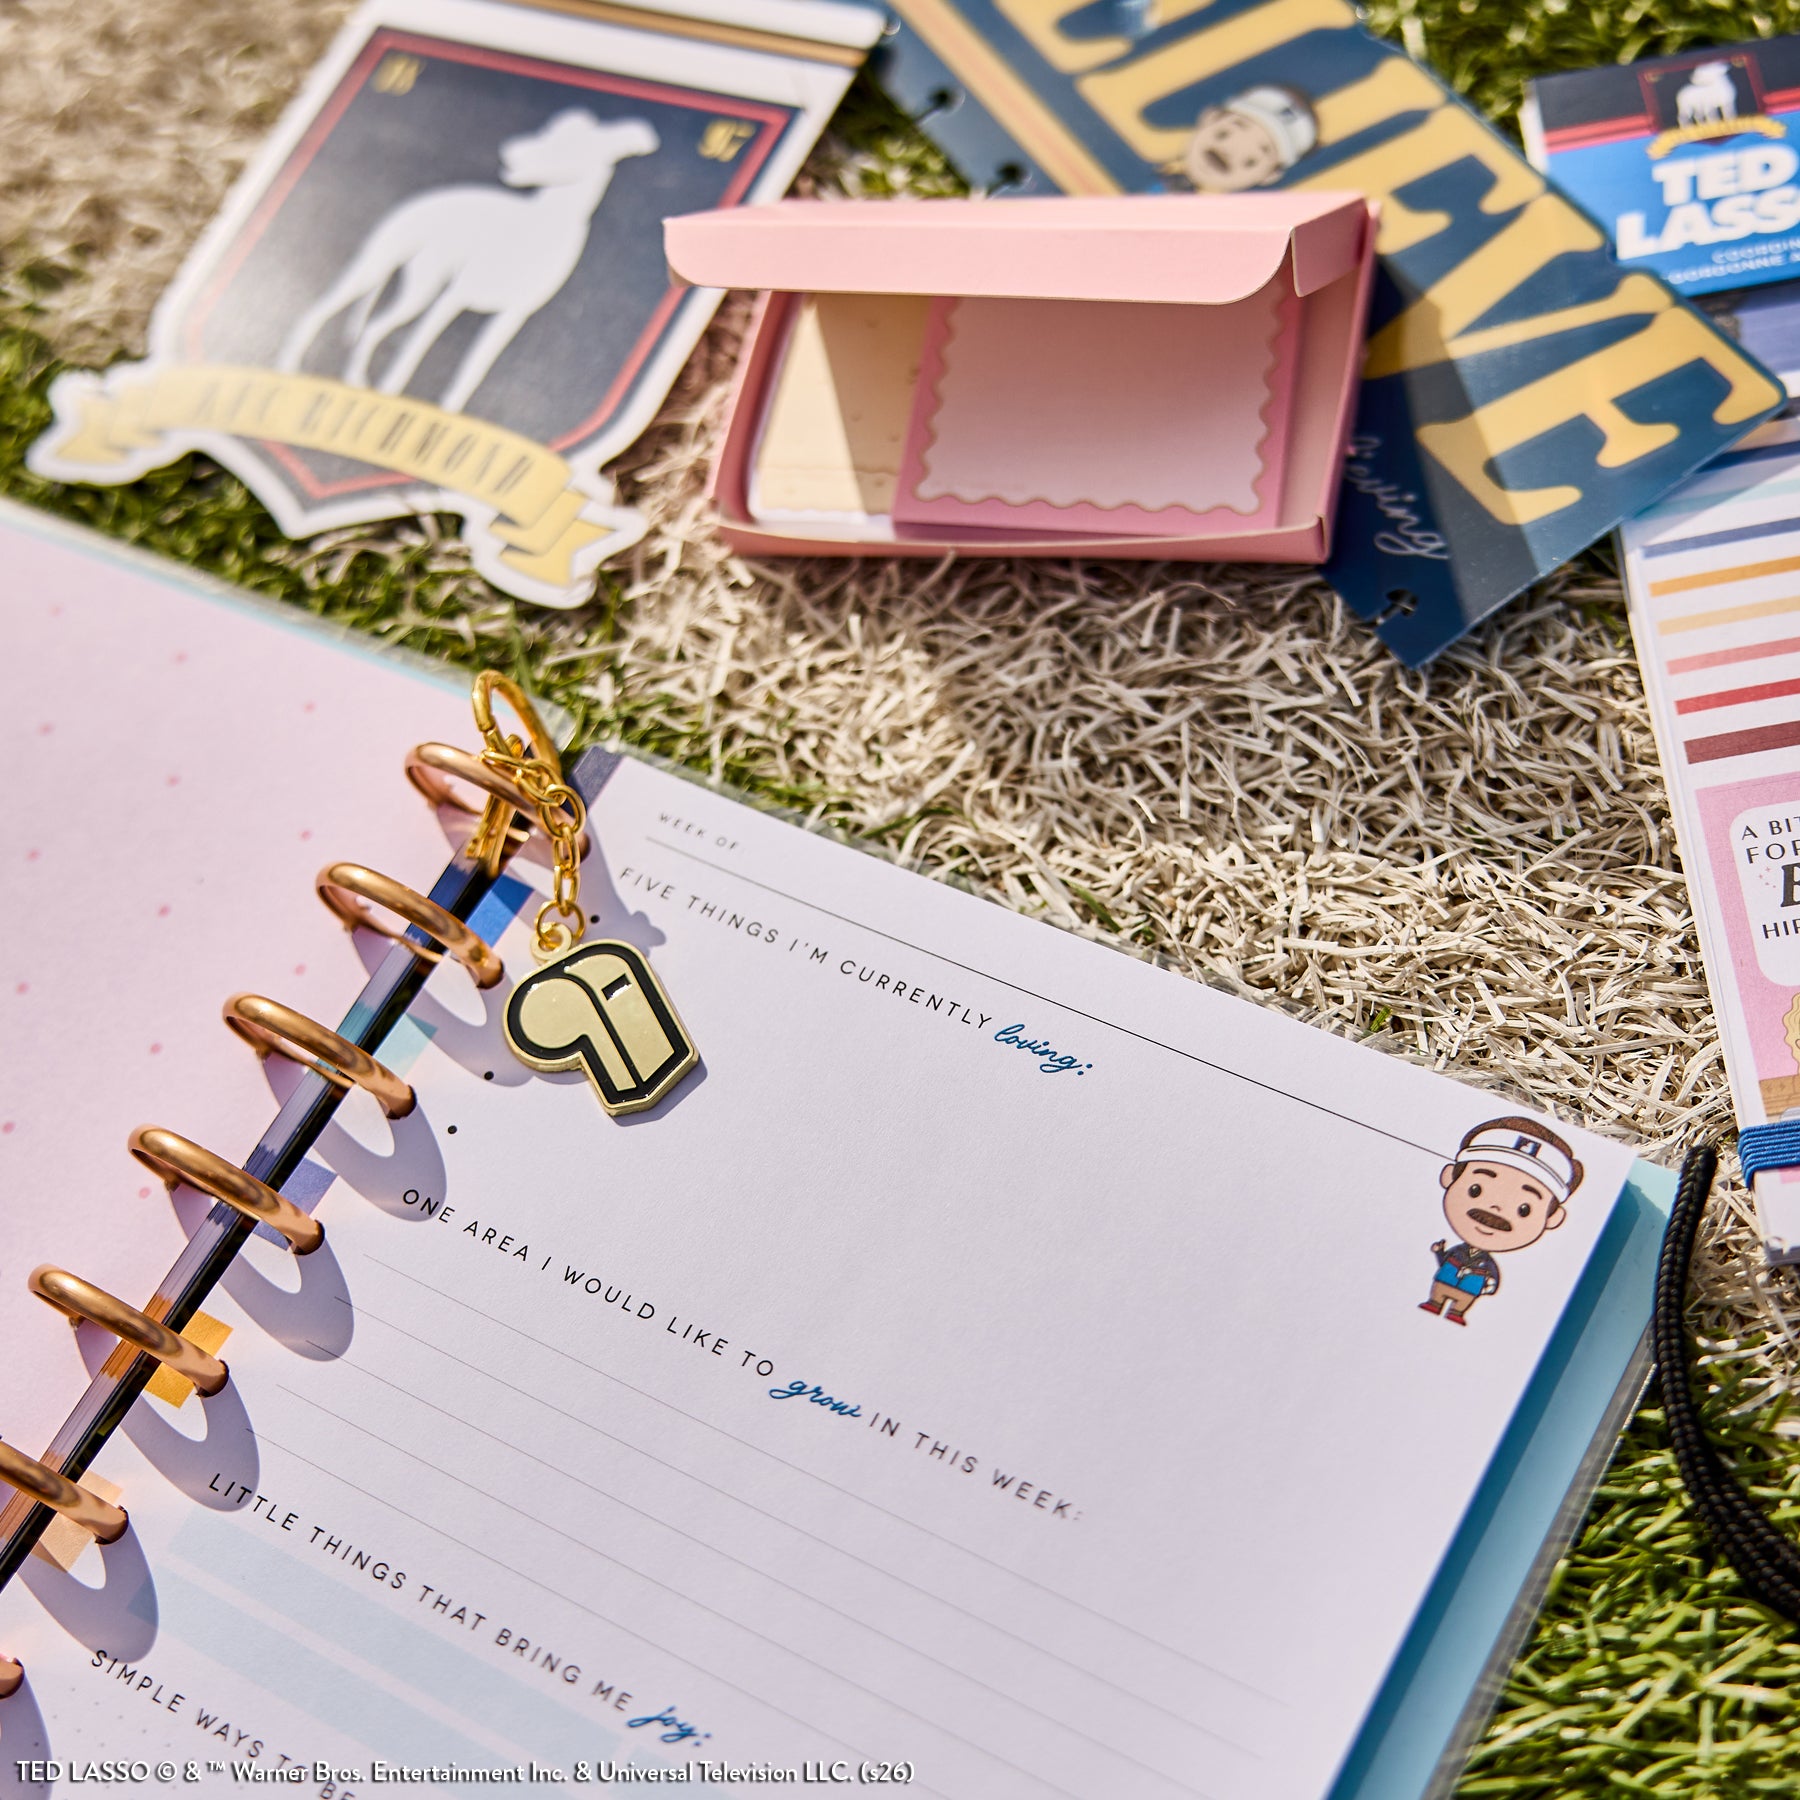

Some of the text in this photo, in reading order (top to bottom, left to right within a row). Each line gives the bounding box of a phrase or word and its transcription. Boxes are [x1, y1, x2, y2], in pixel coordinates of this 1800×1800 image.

[1652, 144, 1799, 206] TED
[658, 811, 708, 839] WEEK
[1741, 825, 1759, 841] A
[619, 867, 1094, 1076] FIVE THINGS I'M CURRENTLY loving:
[402, 1188, 1084, 1522] ONE AREA I WOULD LIKE TO grow IN THIS WEEK:
[208, 1473, 712, 1748] LITTLE THINGS THAT BRING ME joy:
[91, 1649, 186, 1713] SIMPLE
[195, 1708, 264, 1759] WAYS
